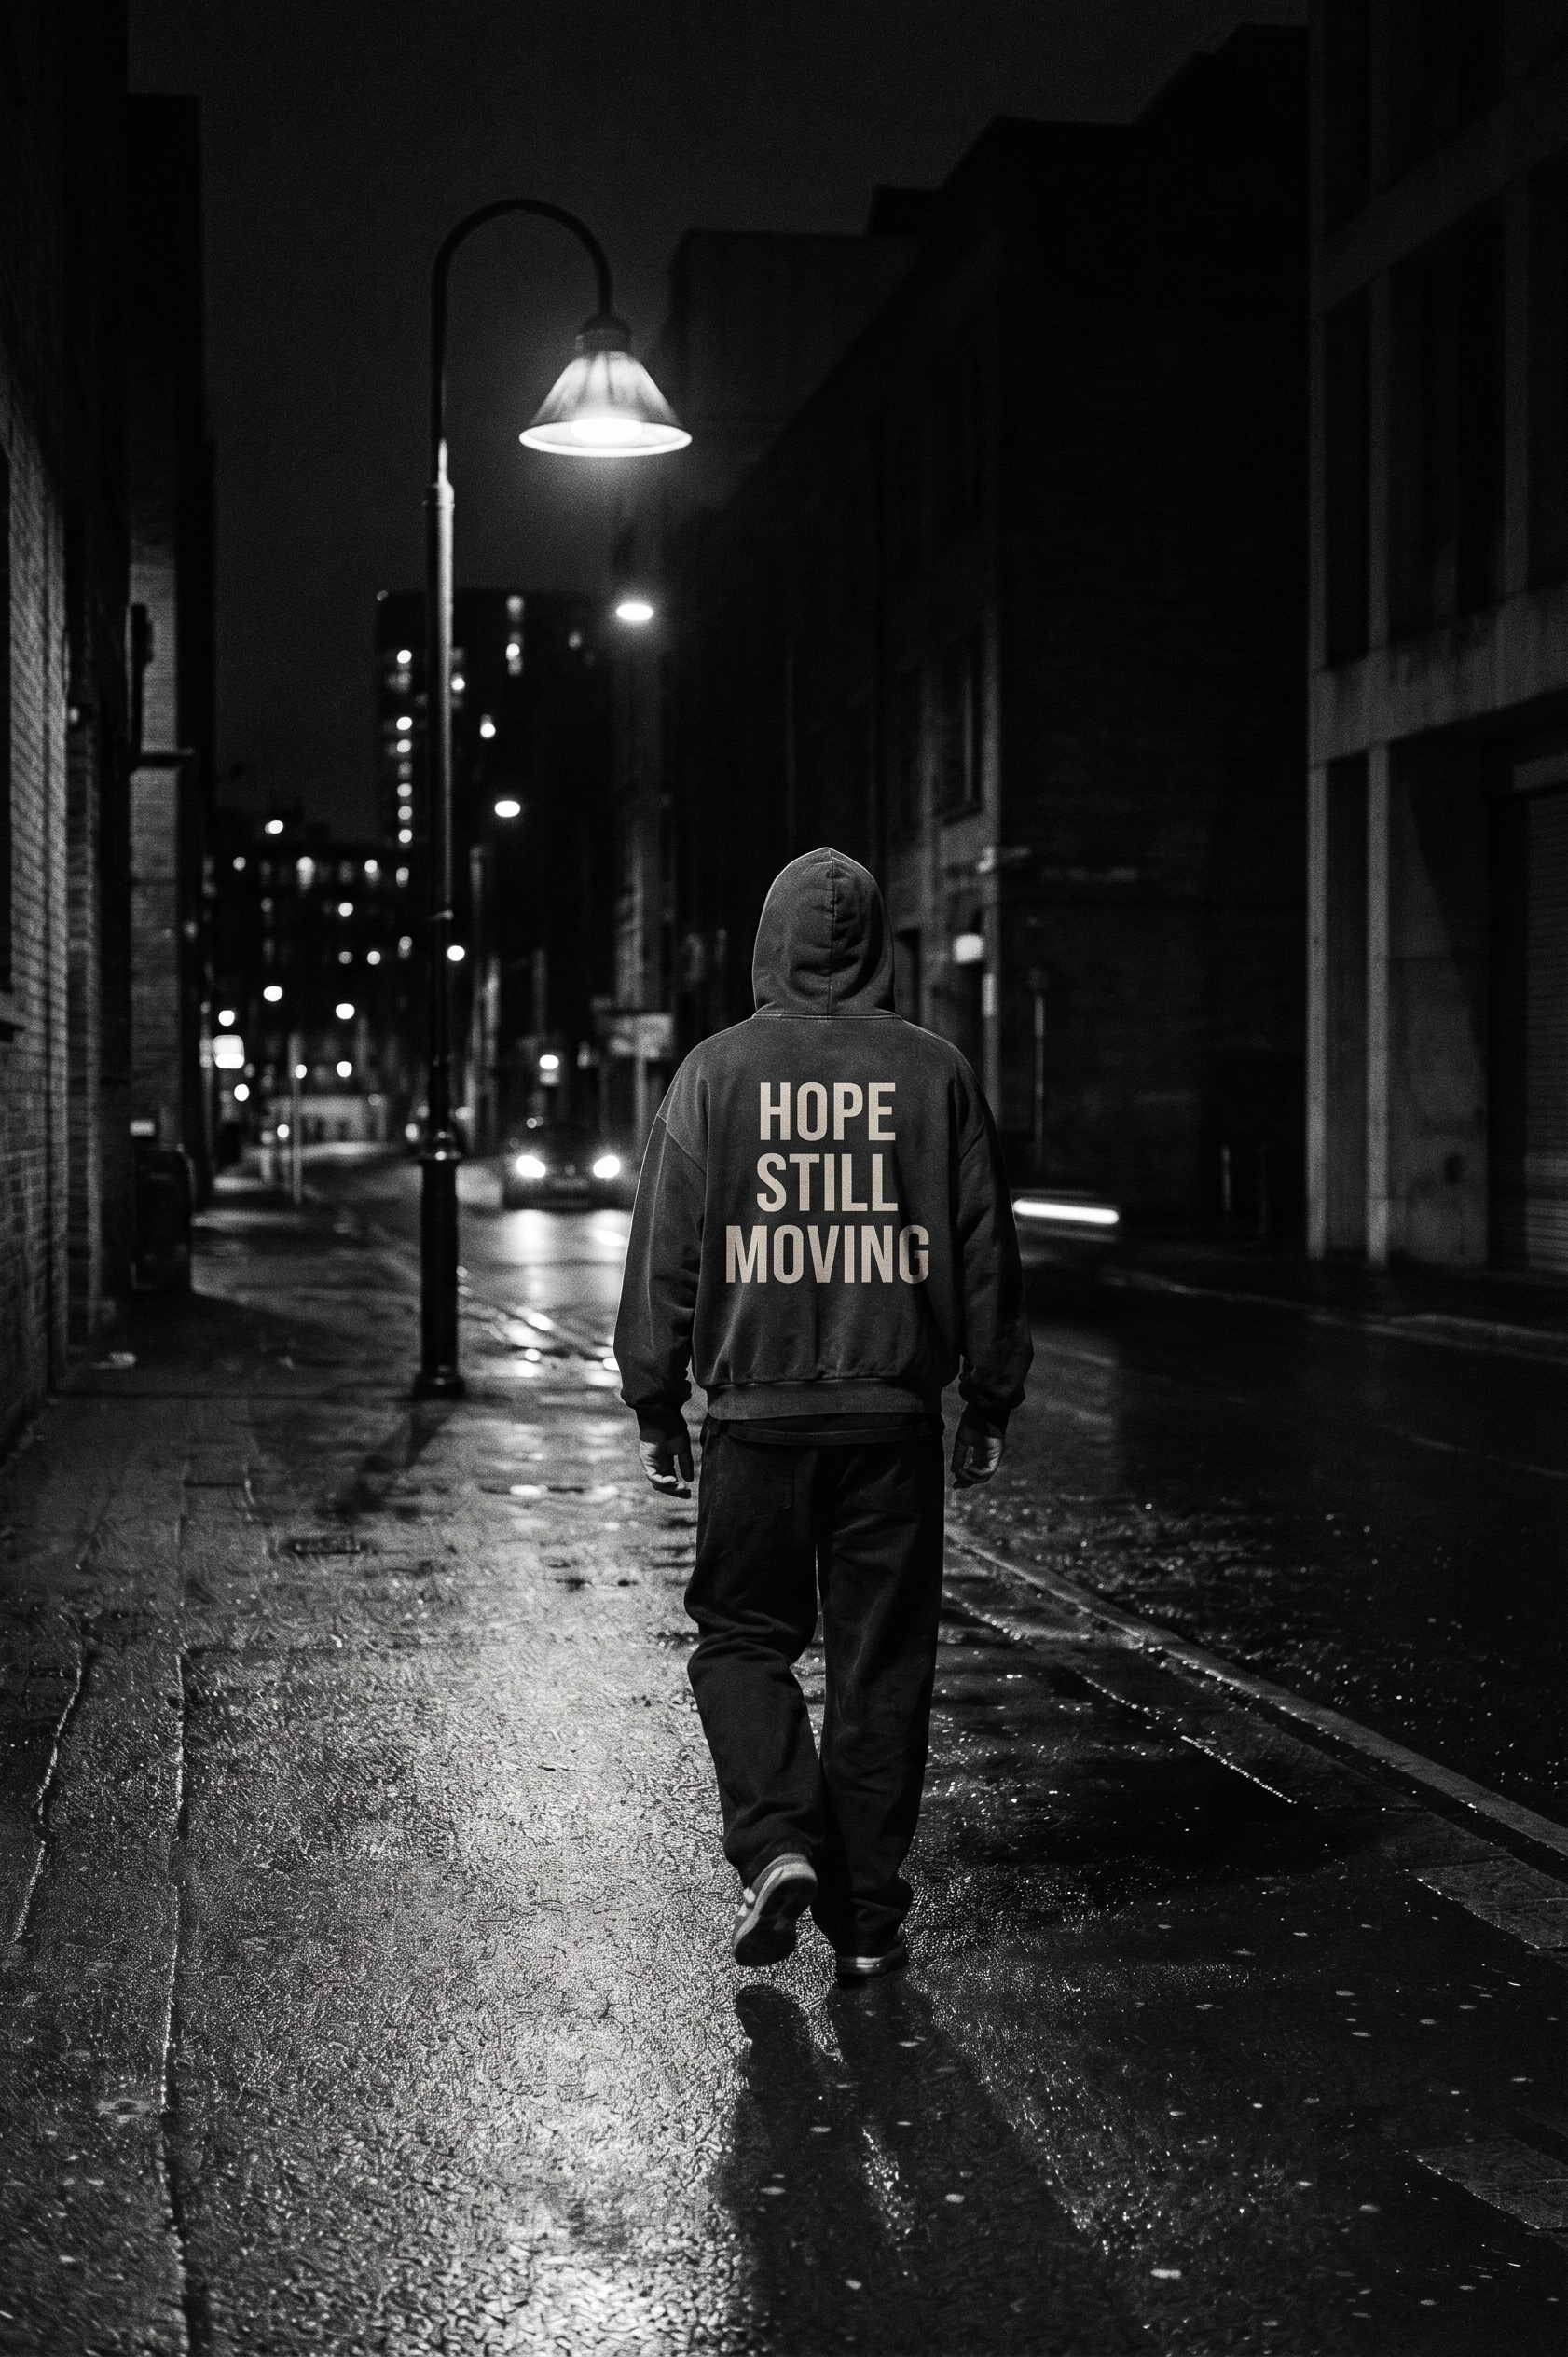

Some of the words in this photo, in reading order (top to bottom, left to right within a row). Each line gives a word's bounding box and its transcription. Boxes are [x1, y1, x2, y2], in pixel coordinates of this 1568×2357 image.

[760, 1082, 896, 1142] HOPE
[756, 1152, 899, 1212] STILL
[725, 1224, 929, 1284] MOVING
